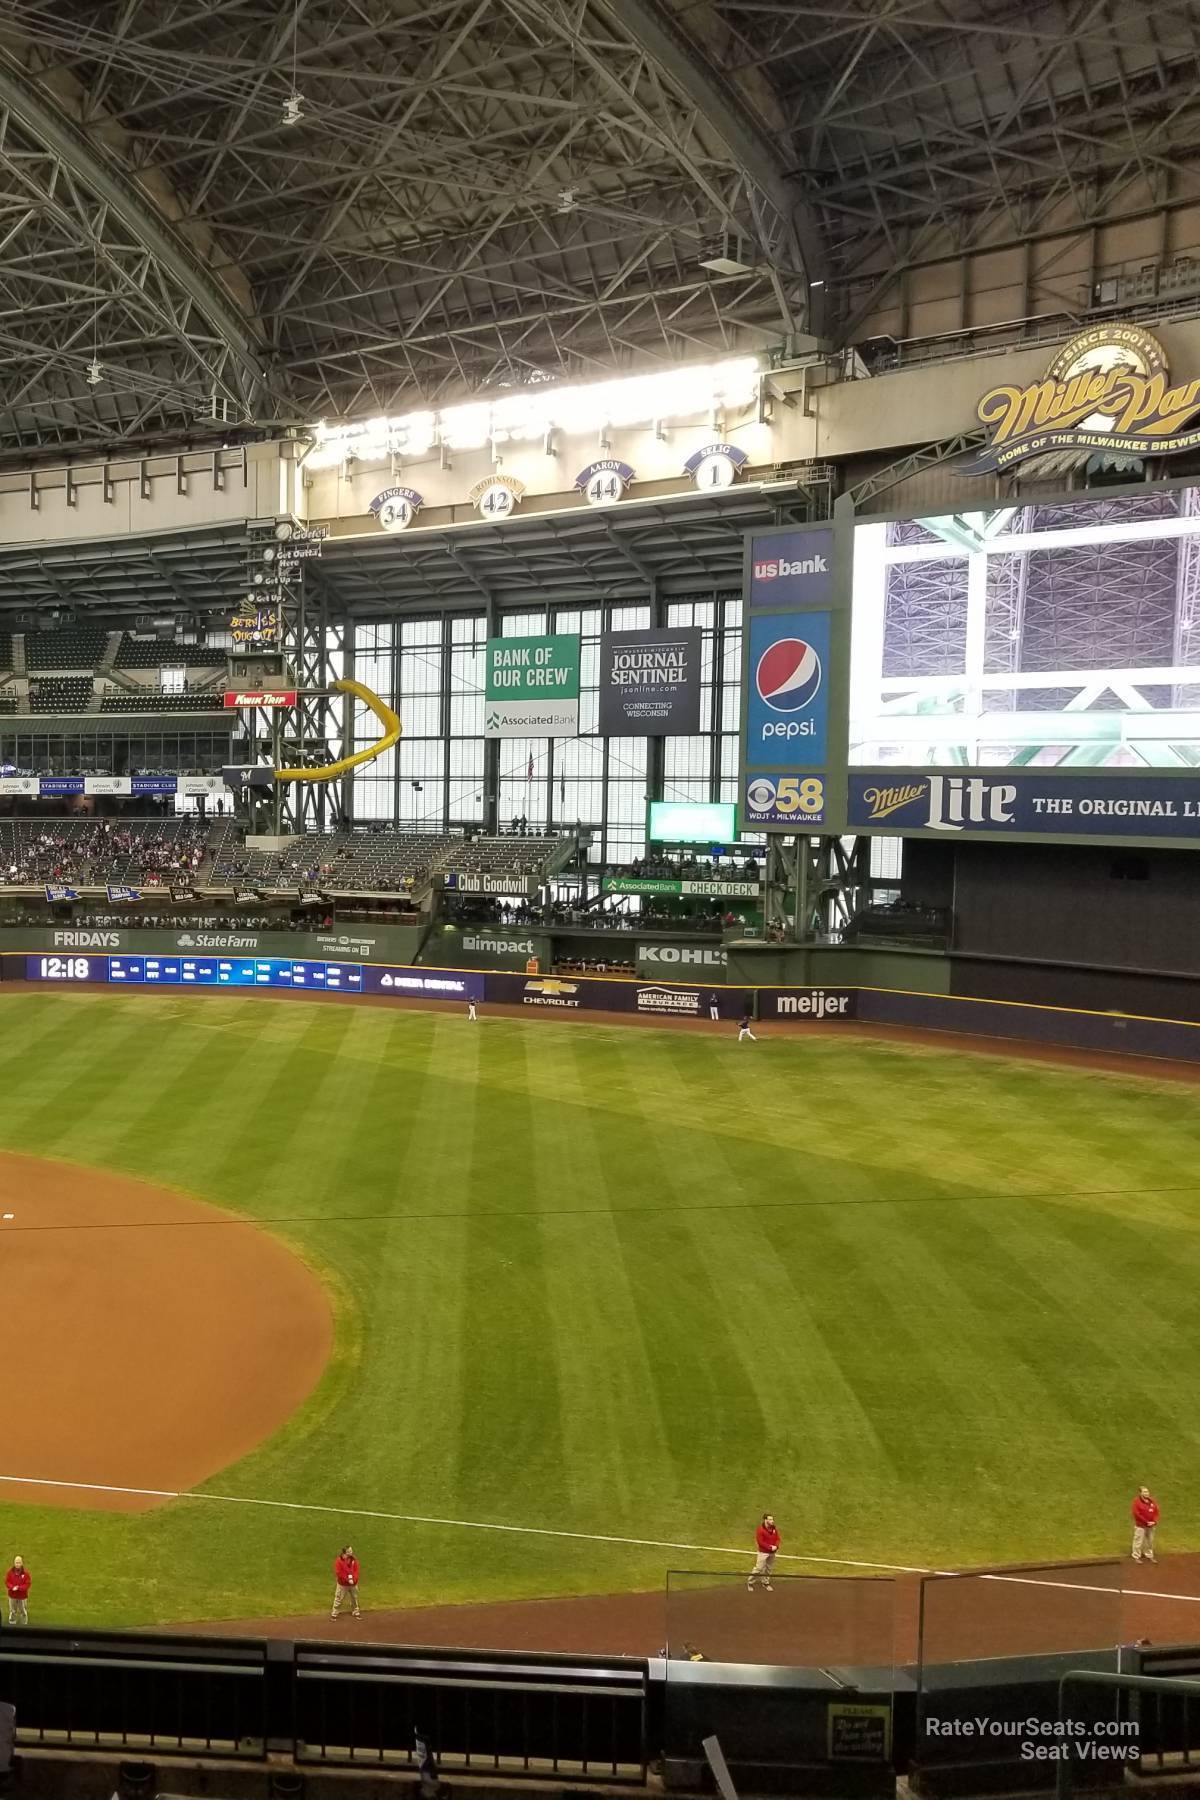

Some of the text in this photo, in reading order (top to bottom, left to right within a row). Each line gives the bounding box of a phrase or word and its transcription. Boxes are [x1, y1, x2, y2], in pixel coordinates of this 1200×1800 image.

[1064, 329, 1145, 361] SINCE 2001
[978, 366, 1130, 446] Miller
[699, 443, 731, 456] SELIG
[998, 444, 1030, 465] HOME
[1031, 437, 1048, 450] OF
[1050, 434, 1074, 445] THE
[1077, 434, 1149, 451] MILWAUKEE
[589, 460, 621, 474] AARON
[709, 464, 721, 487] 1
[378, 487, 415, 502] FINGERS
[590, 477, 618, 500] 44
[482, 491, 510, 514] 42
[383, 503, 409, 524] 34
[265, 577, 278, 585] Get
[232, 628, 276, 641] DUGOUT
[493, 647, 553, 667] BANK OF
[611, 652, 688, 671] JOURNAL
[493, 669, 521, 688] OUR
[611, 667, 688, 685] SENTINEL
[620, 685, 677, 696] jsonline.com
[622, 702, 673, 710] CONNECTING
[626, 709, 669, 718] WISCONSIN
[762, 718, 816, 741] pepsi
[775, 777, 825, 814] 58
[863, 774, 1017, 832] Miller Lite
[749, 812, 822, 821] WDJT MILWAUKEE
[1032, 798, 1073, 815] THE
[1077, 799, 1178, 818] ORIGINAL
[458, 875, 528, 894] Club Goodwill
[689, 882, 723, 895] CHECK
[726, 883, 753, 896] DECK
[54, 931, 120, 947] FRIDAYS
[475, 934, 534, 954] impact
[39, 957, 89, 979] 12:18
[523, 996, 580, 1008] CHEVROLET
[638, 993, 699, 1002] AMERICAN FAMILY
[777, 991, 849, 1019] meijer
